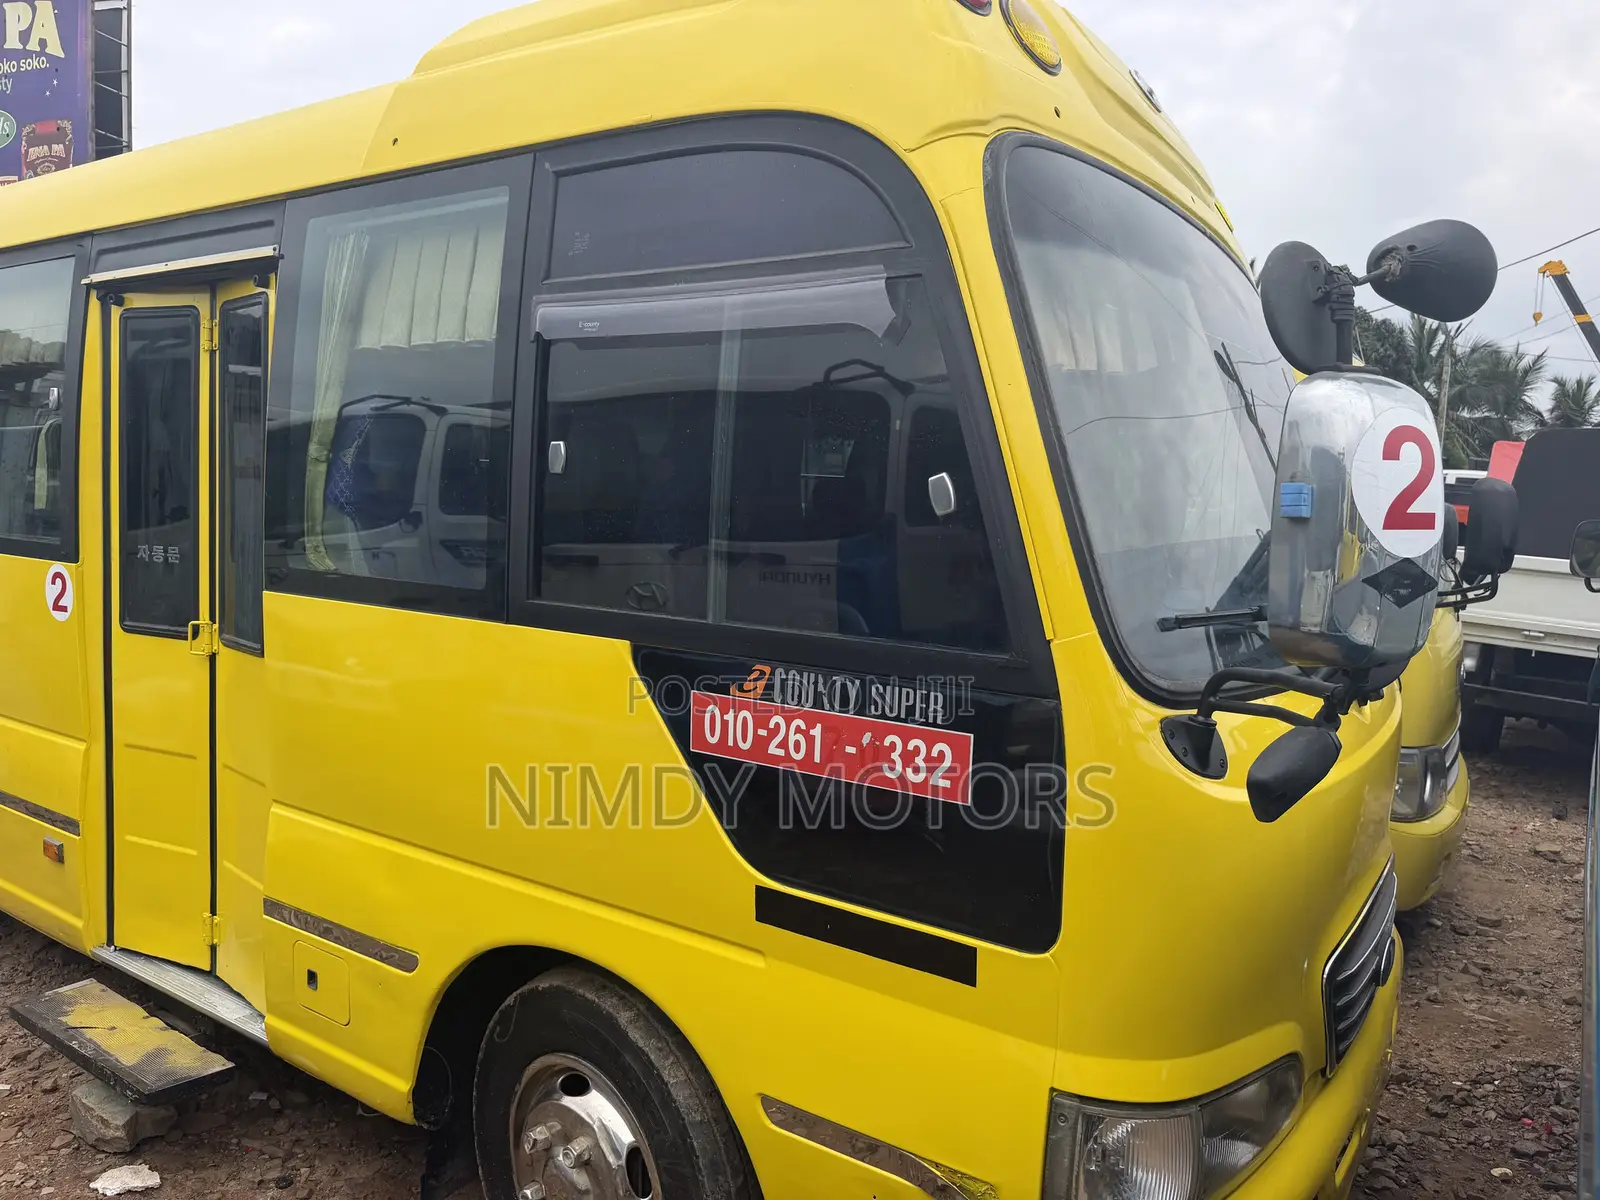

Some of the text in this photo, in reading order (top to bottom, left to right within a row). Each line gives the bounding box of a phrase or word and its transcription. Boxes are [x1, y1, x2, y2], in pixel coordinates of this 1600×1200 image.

[3, 0, 65, 58] PA
[20, 54, 50, 72] soko.
[1382, 425, 1436, 530] 2
[137, 544, 180, 564] 자동문
[51, 571, 69, 613] 2
[871, 684, 944, 725] SUPER
